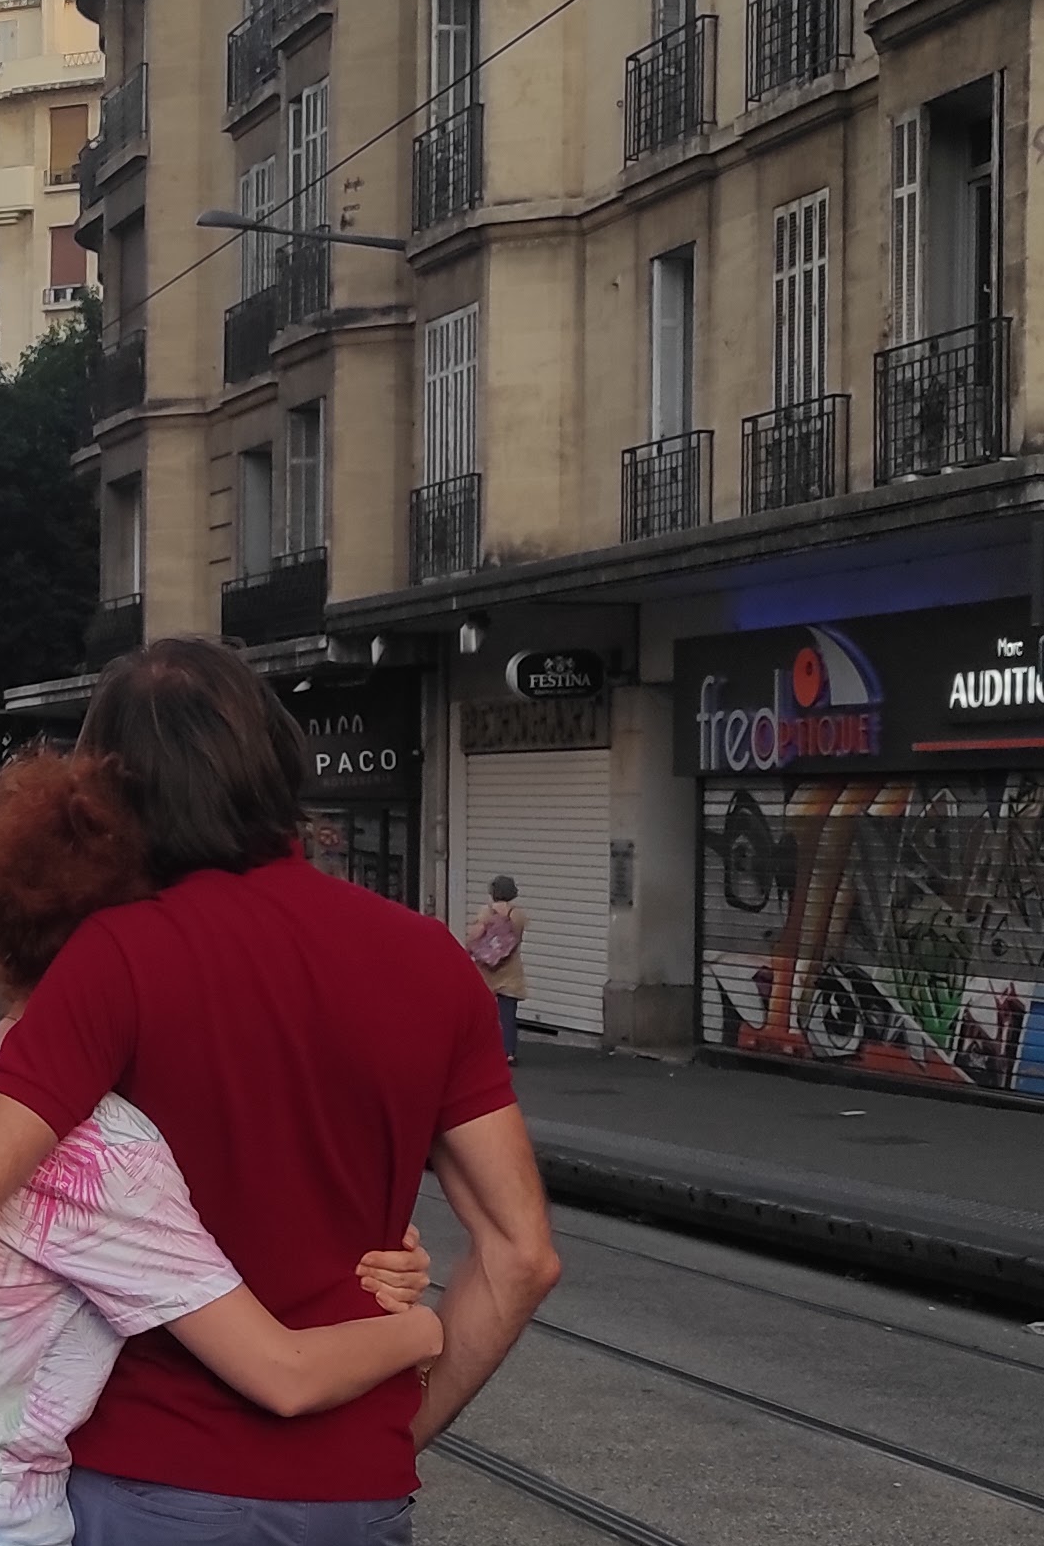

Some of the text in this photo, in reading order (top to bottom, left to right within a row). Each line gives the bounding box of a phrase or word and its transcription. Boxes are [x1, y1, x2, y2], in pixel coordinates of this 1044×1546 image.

[529, 673, 591, 689] FESTINA
[696, 669, 780, 771] fred
[316, 749, 397, 776] PACO
